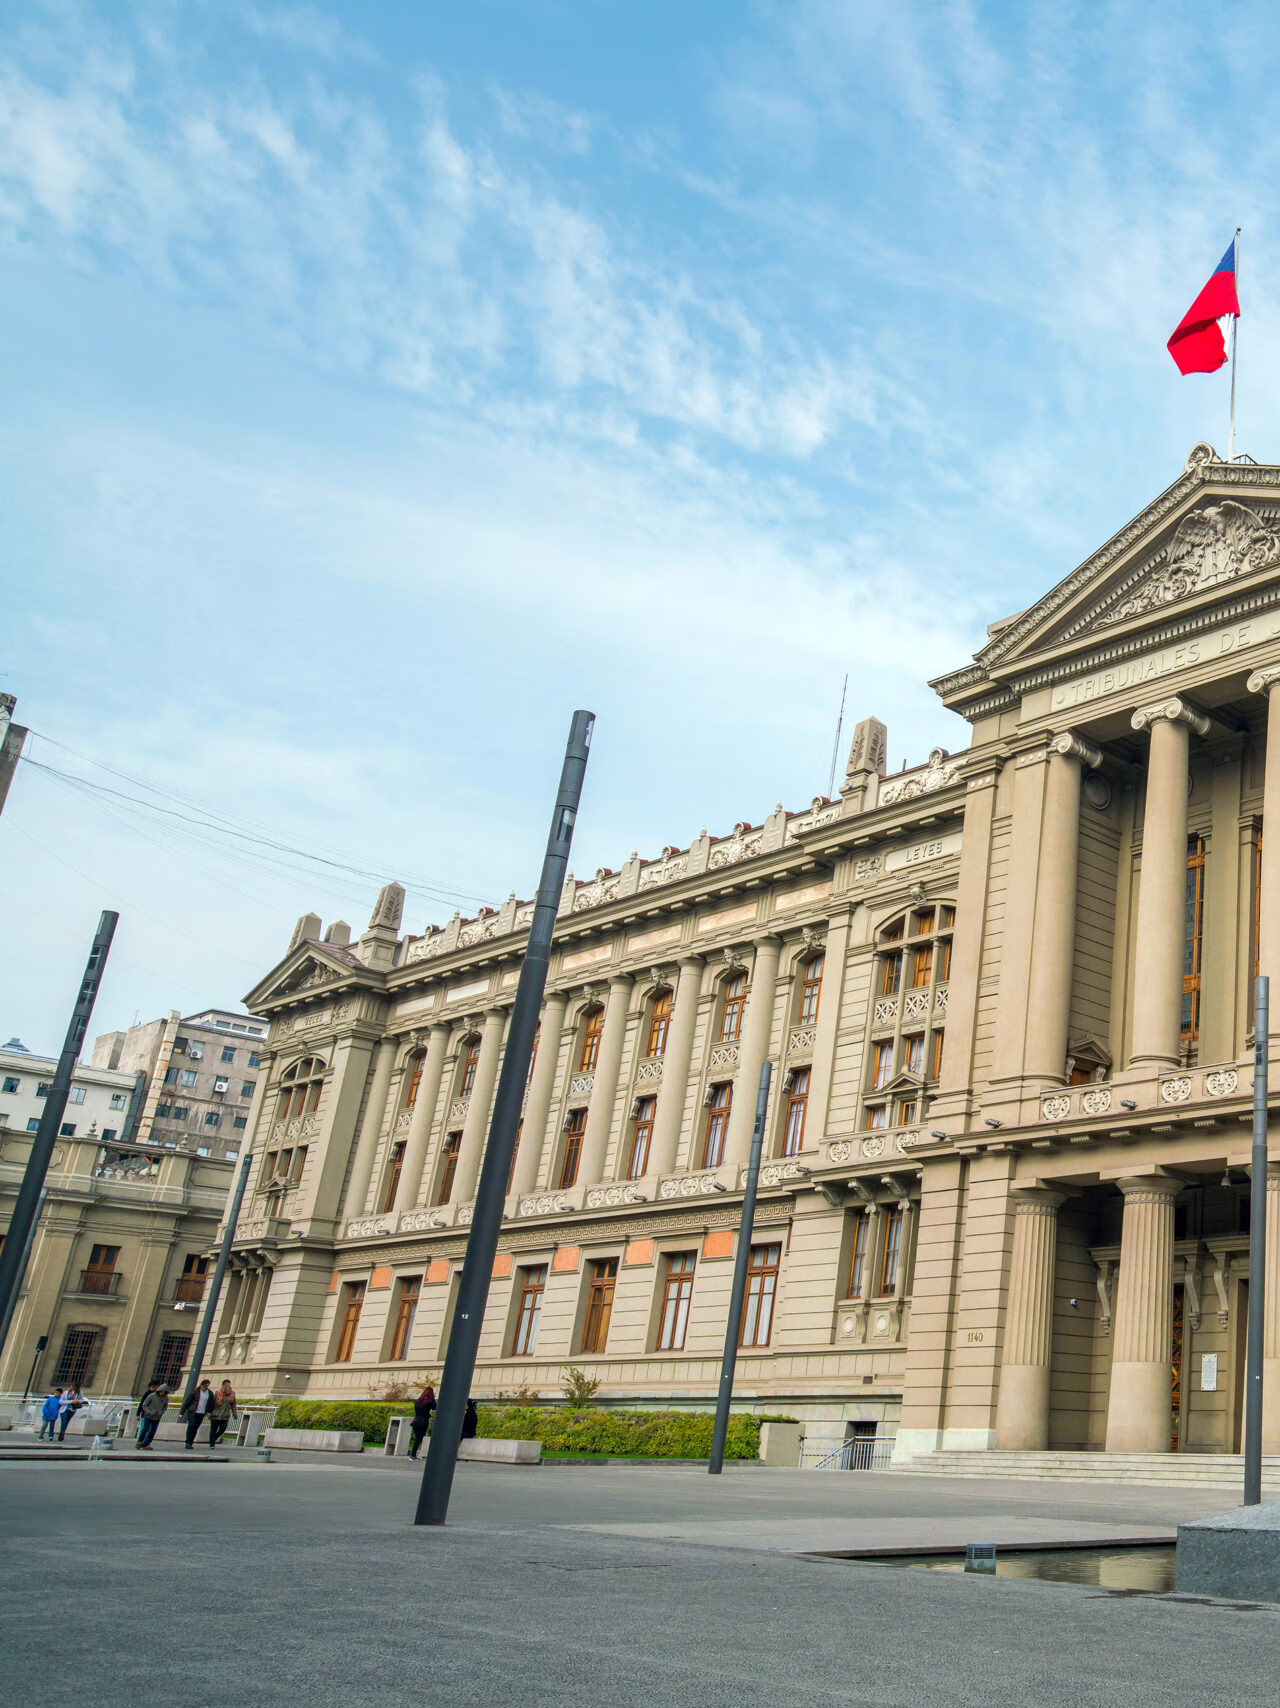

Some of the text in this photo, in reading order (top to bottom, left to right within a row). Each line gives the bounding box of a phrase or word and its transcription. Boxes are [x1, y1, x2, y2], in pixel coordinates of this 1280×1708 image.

[1071, 642, 1200, 703] TRIBUNALES
[1220, 625, 1251, 654] DE
[905, 840, 943, 863] LEYES
[967, 1332, 984, 1343] 1140
